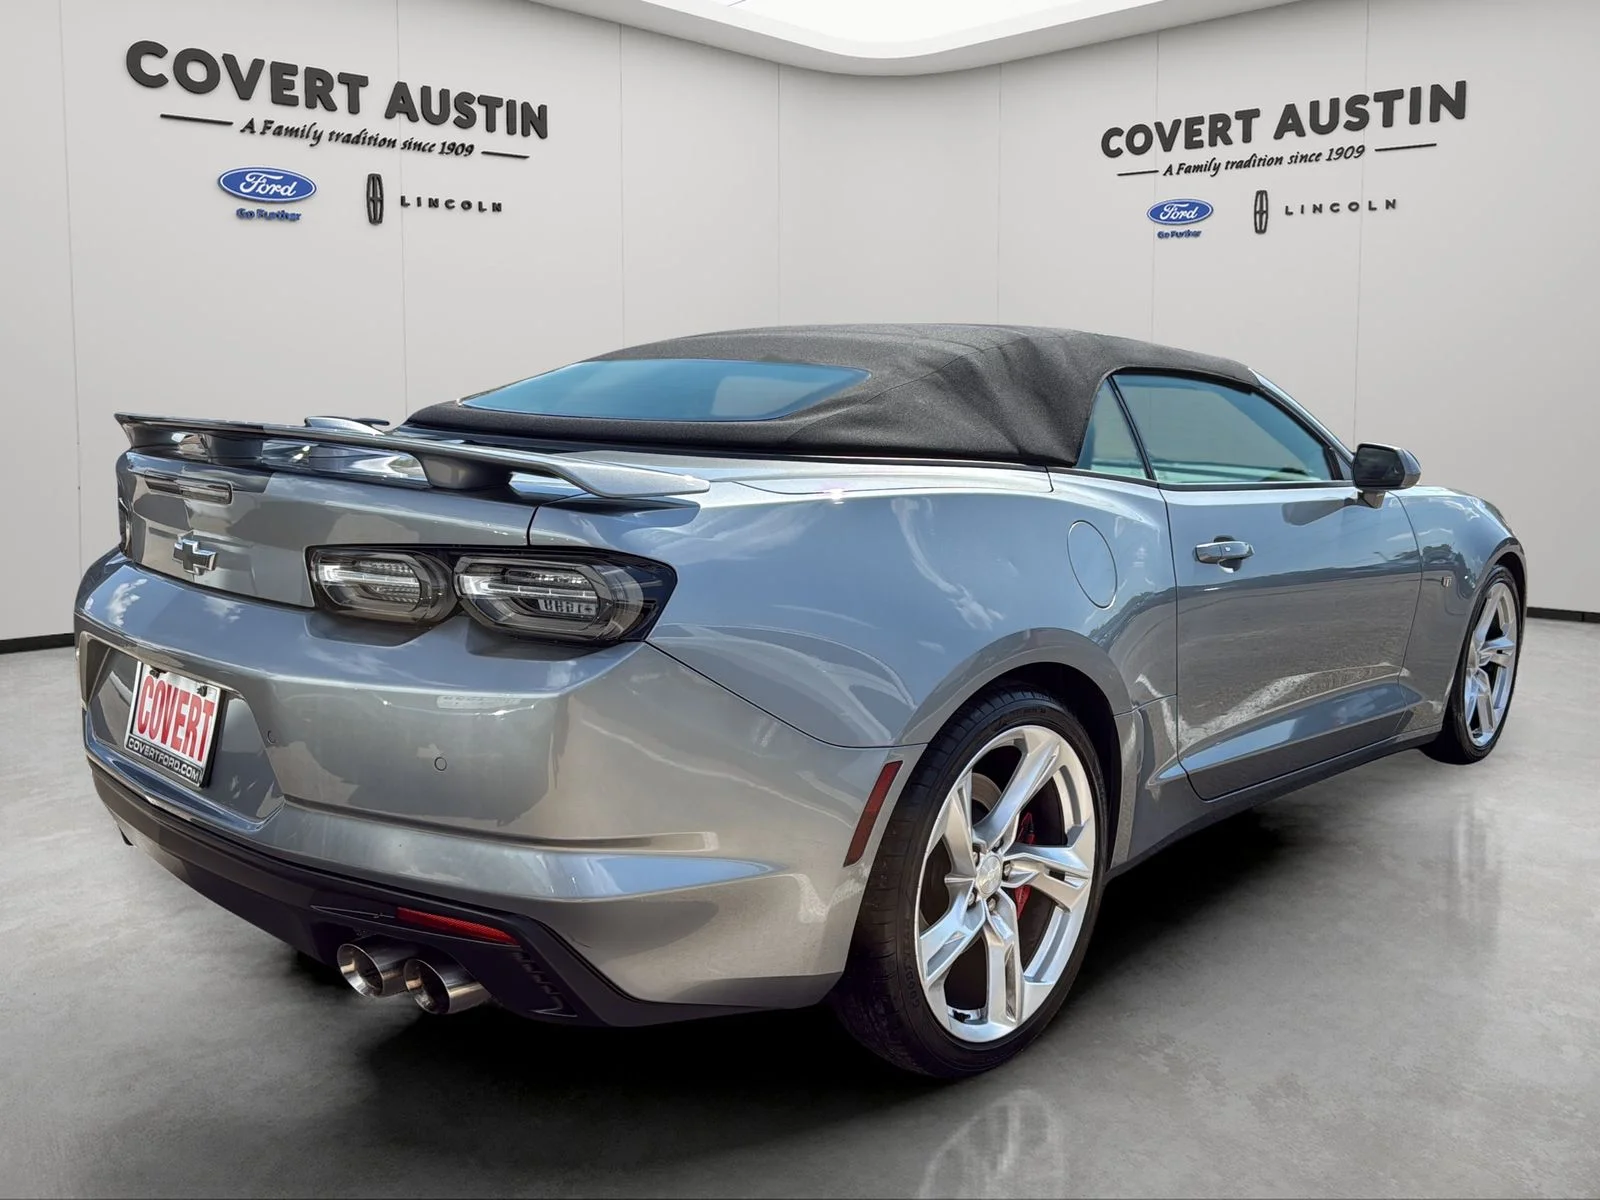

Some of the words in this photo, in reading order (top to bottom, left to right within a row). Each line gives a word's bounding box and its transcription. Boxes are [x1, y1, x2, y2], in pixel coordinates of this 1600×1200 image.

[126, 40, 369, 114] COVERT
[384, 81, 549, 140] AUSTIN
[240, 118, 256, 134] A
[260, 119, 323, 147] Family
[328, 128, 397, 149] tradition
[401, 137, 436, 153] since
[438, 141, 475, 157] 1909
[1101, 108, 1261, 159] COVERT
[1273, 80, 1467, 140] AUSTIN
[1163, 164, 1174, 176] A
[1176, 157, 1221, 178] Family
[1225, 153, 1284, 170] tradition
[1287, 151, 1323, 165] since
[1325, 144, 1365, 161] 1909
[239, 172, 298, 197] Ford
[400, 195, 502, 213] LINCOLN
[1160, 203, 1199, 220] Ford
[1284, 198, 1396, 216] LINCOLN
[137, 675, 215, 763] COVERT
[128, 738, 200, 782] COVERTFORD.COM
